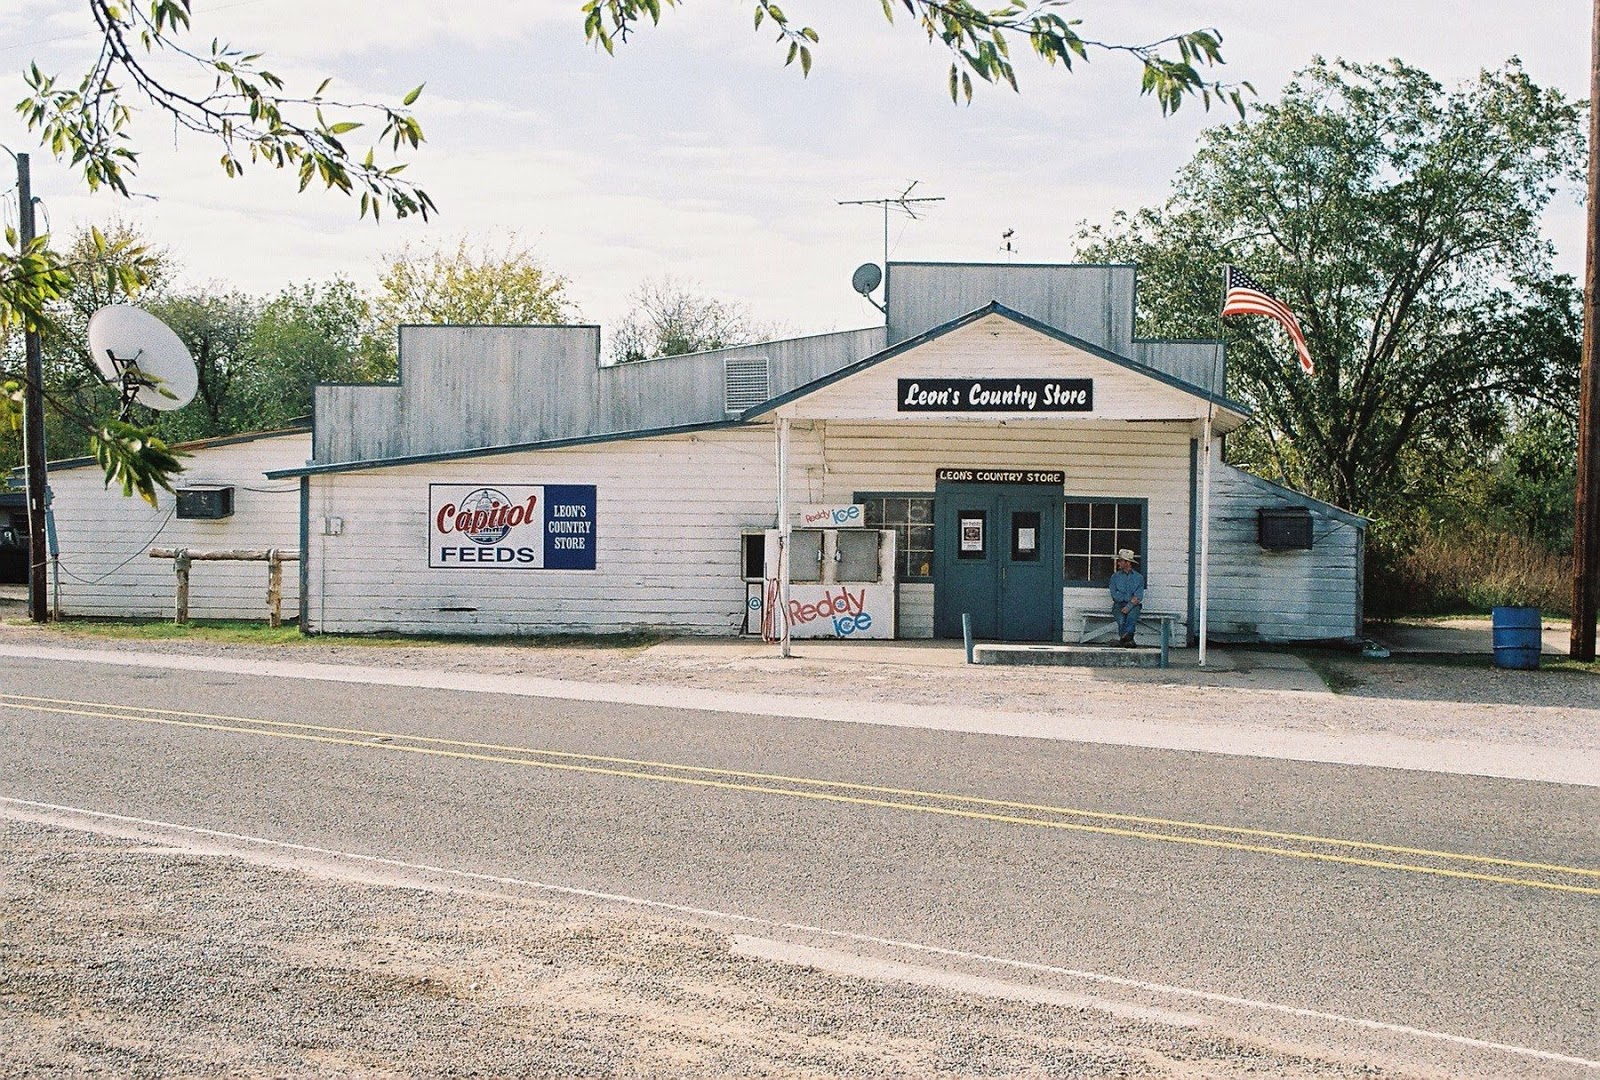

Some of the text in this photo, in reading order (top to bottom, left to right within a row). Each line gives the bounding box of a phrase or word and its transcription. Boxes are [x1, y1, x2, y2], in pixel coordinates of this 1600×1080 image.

[904, 383, 1087, 410] Leon's Country Store
[940, 470, 1061, 483] LEON'S COUNTRY STORE
[436, 494, 538, 535] Capitol
[553, 505, 587, 518] LEON'S
[805, 506, 860, 524] Reddy ice
[548, 521, 592, 534] COUNTRY
[554, 537, 586, 550] STORE
[441, 547, 535, 563] FEEDS
[788, 586, 866, 626] Reddy
[832, 612, 873, 637] ice
